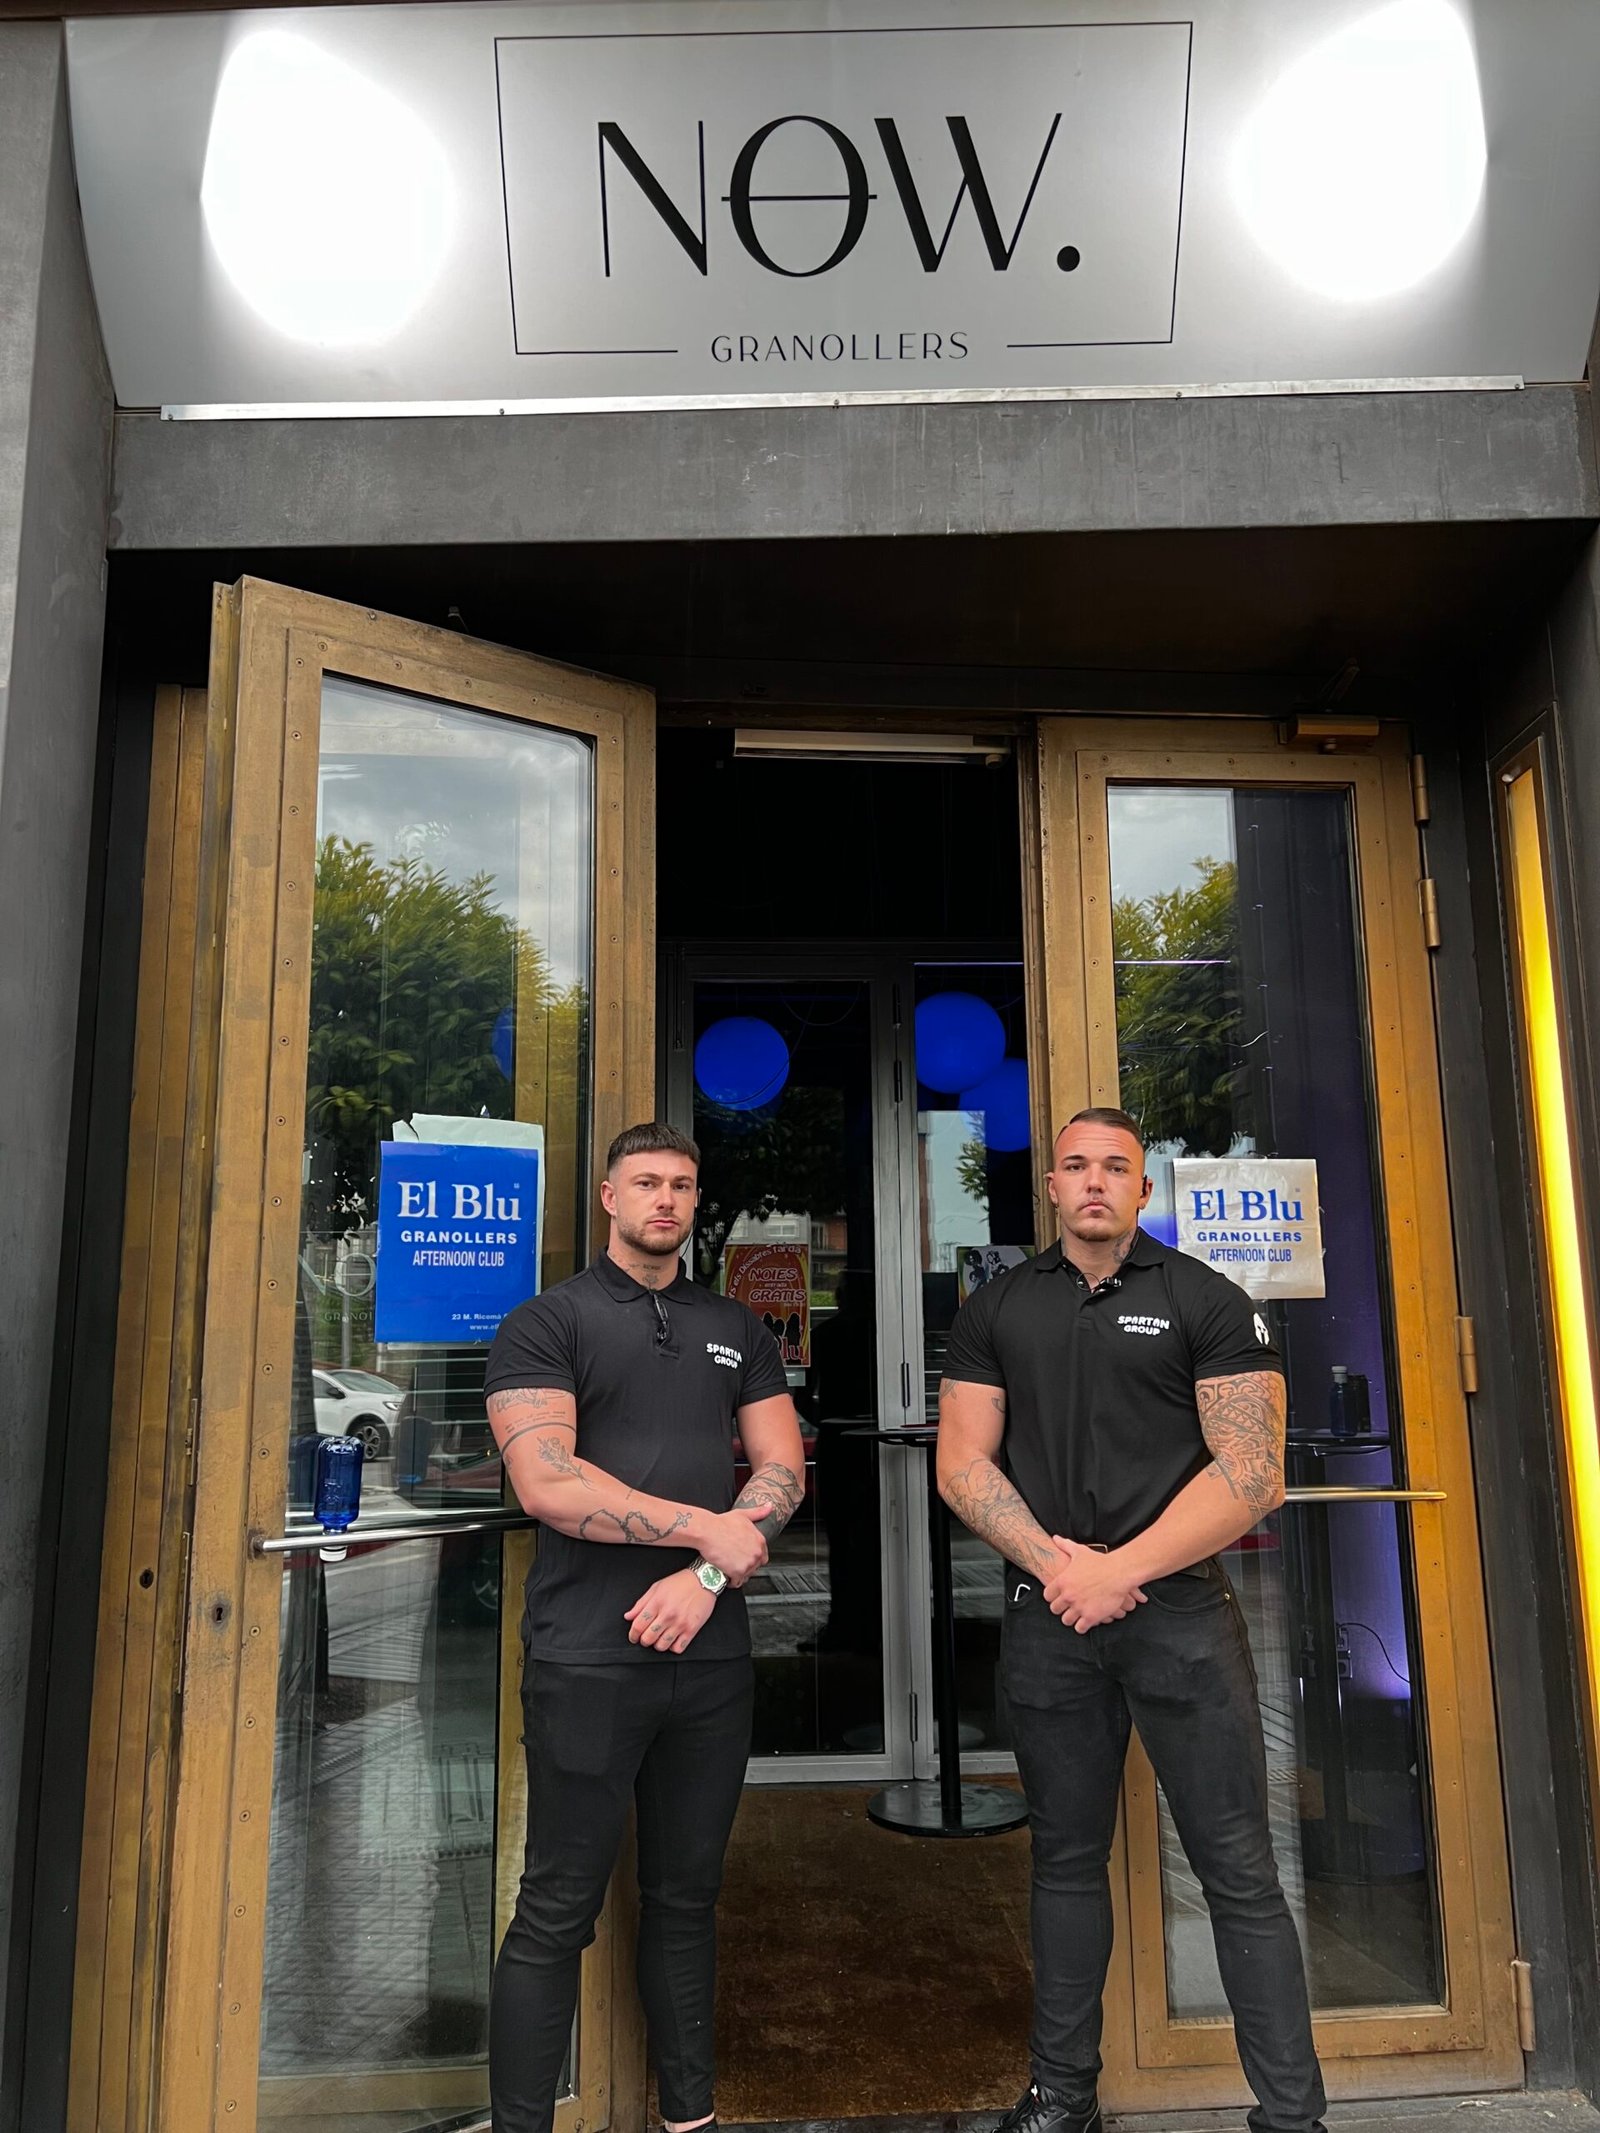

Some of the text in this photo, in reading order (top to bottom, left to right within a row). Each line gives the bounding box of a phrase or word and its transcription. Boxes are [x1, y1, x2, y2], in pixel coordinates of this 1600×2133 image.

[597, 112, 1081, 278] NOW.
[710, 331, 970, 364] GRANOLLERS
[397, 1180, 521, 1221] El Blu
[1190, 1188, 1305, 1221] El Blu
[400, 1230, 518, 1245] GRANOLLERS
[1197, 1231, 1303, 1242] GRANOLLERS
[412, 1251, 505, 1267] AFTERNOON CLUB
[1209, 1248, 1292, 1262] AFTERNOON CLUB
[748, 1267, 799, 1281] NOIES
[748, 1288, 807, 1303] GRATIS
[1117, 1315, 1170, 1330] SPARTAN
[1123, 1324, 1161, 1336] GROUP
[781, 1336, 805, 1361] lu
[713, 1354, 738, 1369] GROUP
